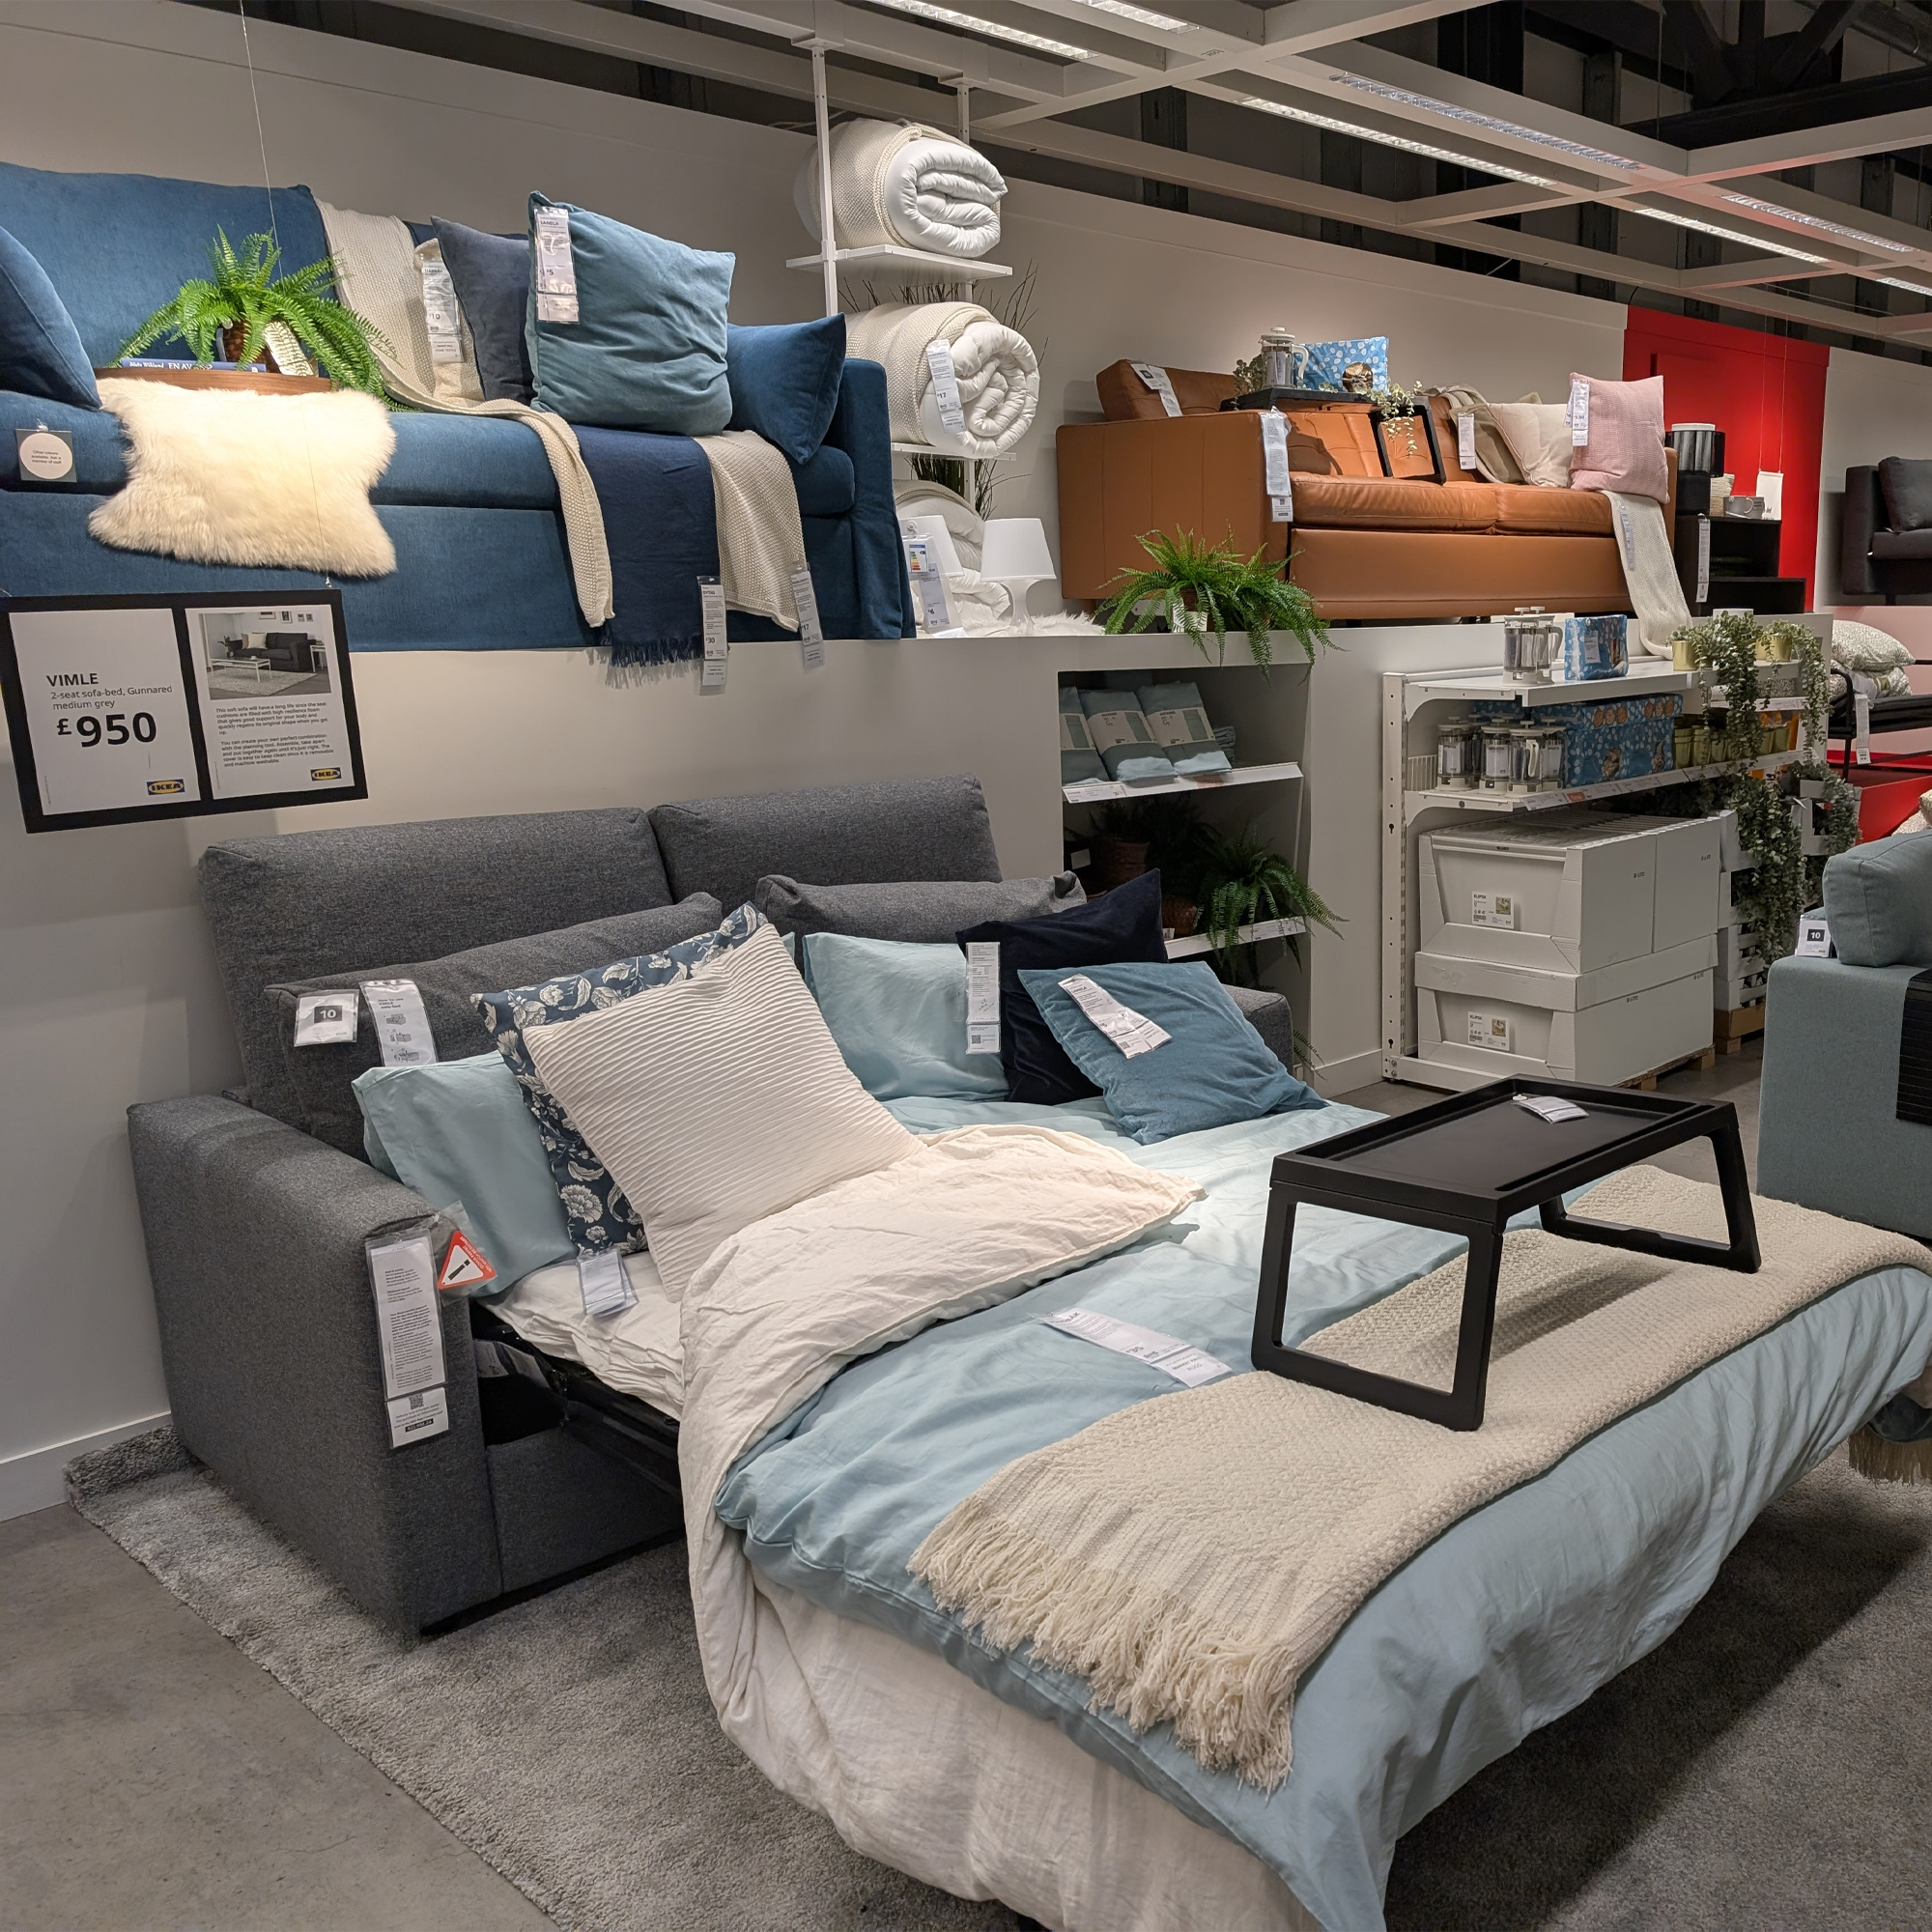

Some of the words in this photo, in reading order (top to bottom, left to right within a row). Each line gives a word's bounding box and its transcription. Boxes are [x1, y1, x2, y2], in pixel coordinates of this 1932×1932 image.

[46, 673, 99, 687] VIMLE
[51, 690, 80, 699] 2-seat
[82, 688, 125, 697] sofa-bed,
[128, 685, 172, 695] Gunnared
[53, 699, 92, 710] medium
[95, 700, 115, 710] grey
[57, 712, 156, 748] £950
[320, 1009, 337, 1019] 10
